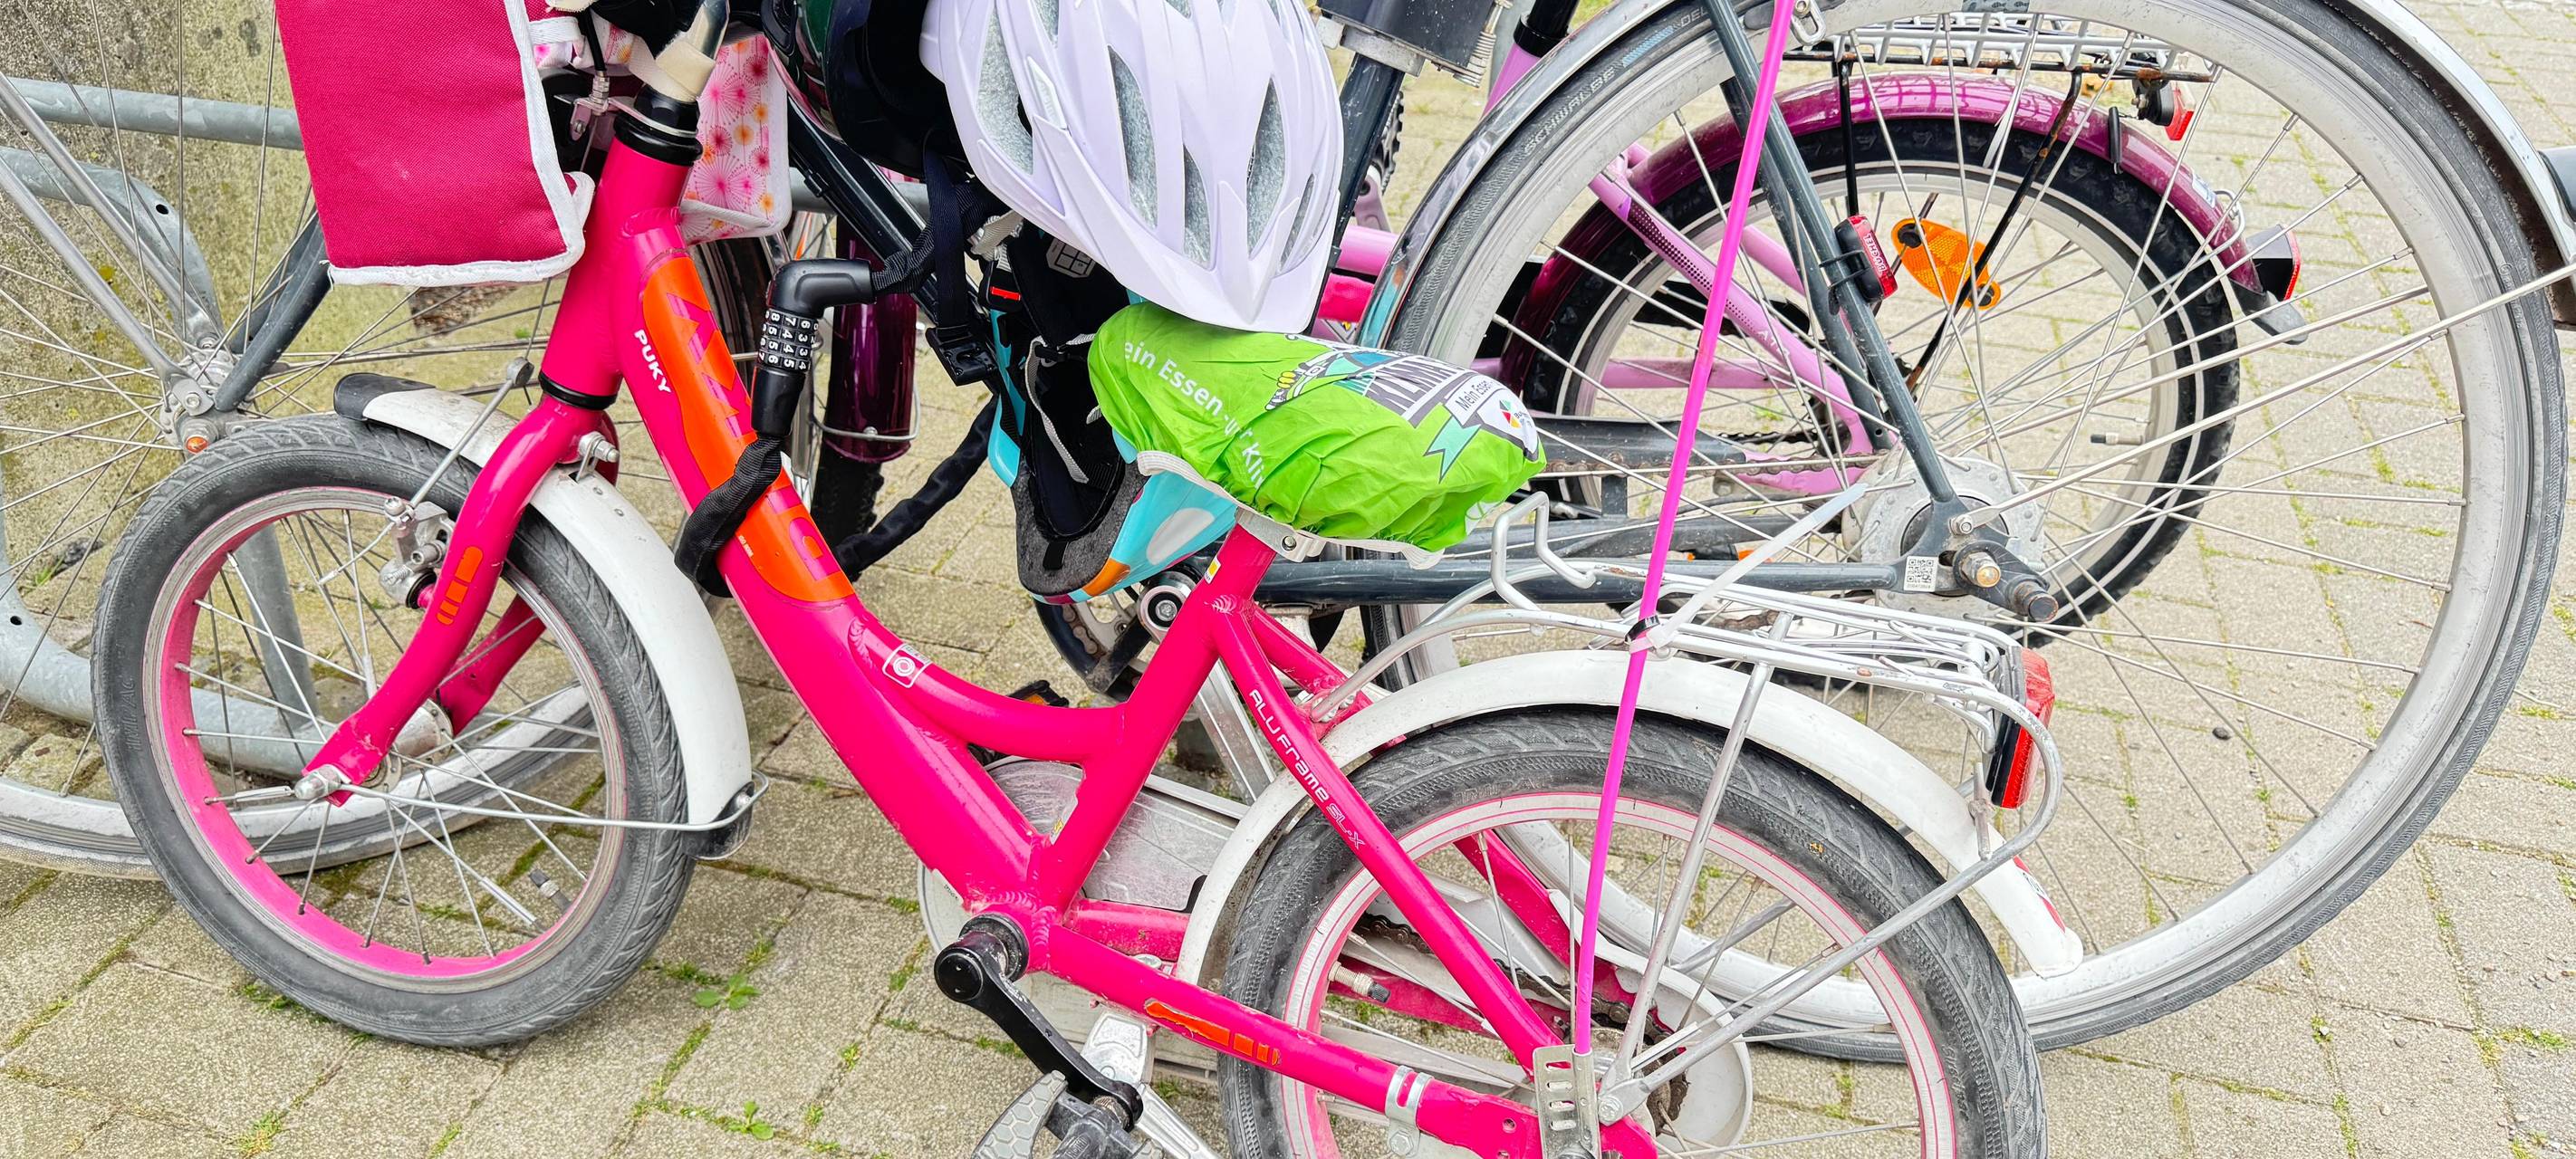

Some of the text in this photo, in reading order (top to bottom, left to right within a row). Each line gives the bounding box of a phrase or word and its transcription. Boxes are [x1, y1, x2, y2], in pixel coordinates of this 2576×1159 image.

[1523, 65, 1616, 156] SCHWALBE
[634, 329, 672, 393] PUKY
[1158, 359, 1224, 417] Essen
[1454, 388, 1481, 411] Mein
[1248, 688, 1282, 735] ALU
